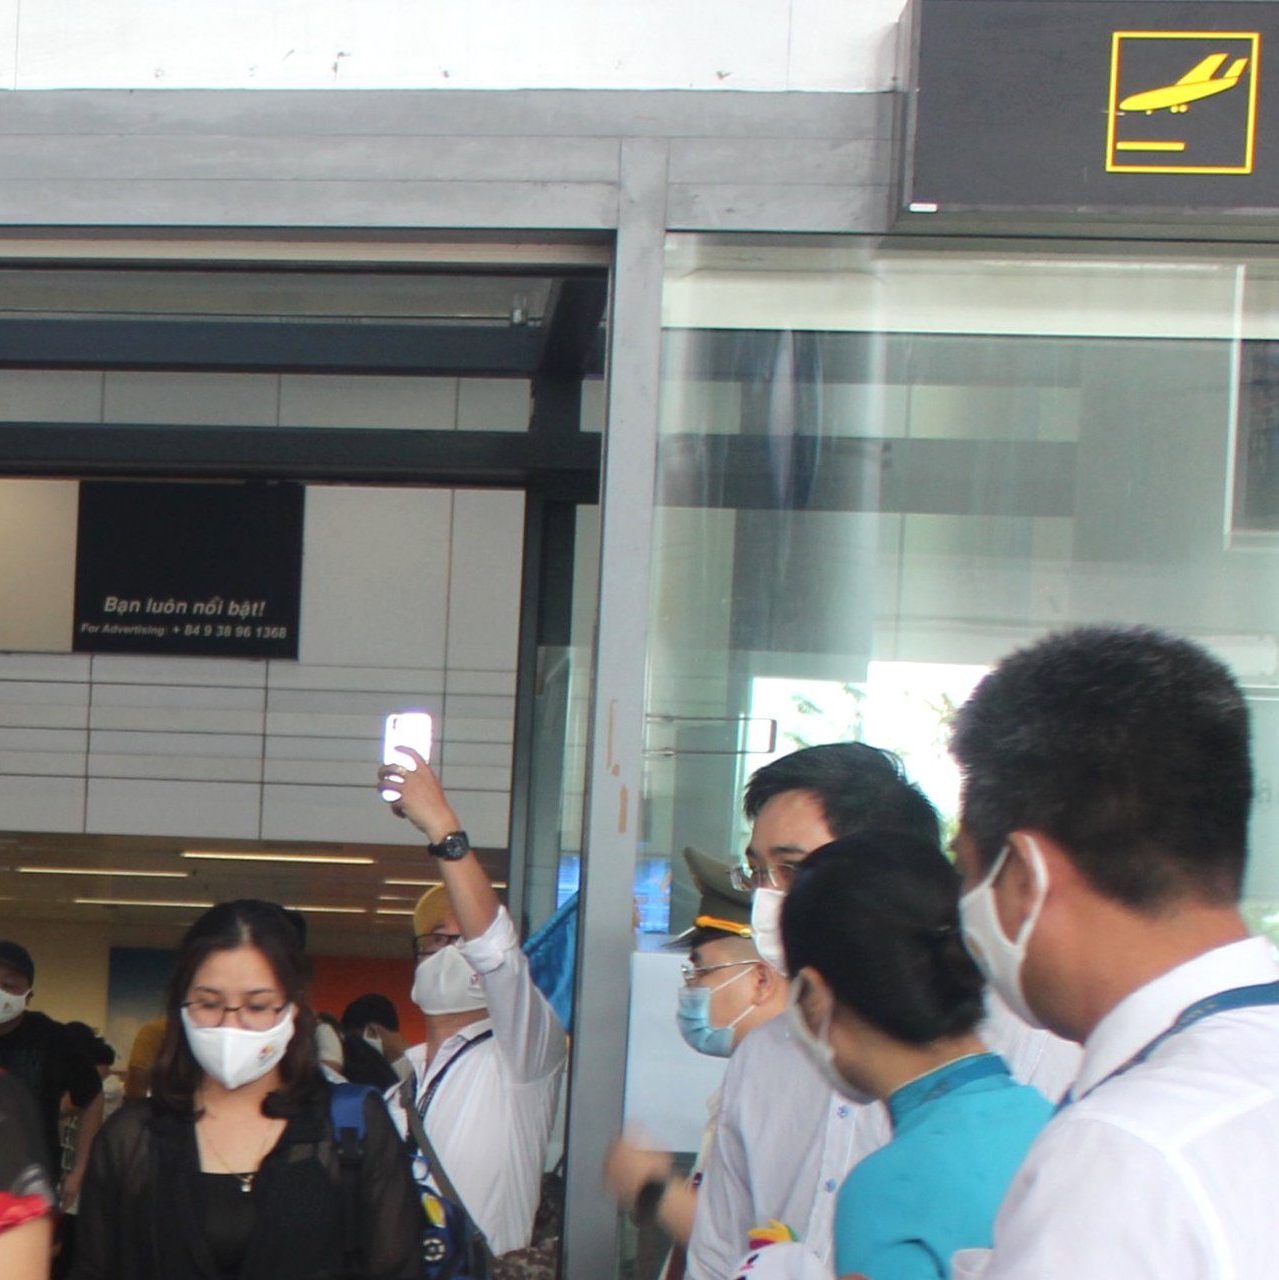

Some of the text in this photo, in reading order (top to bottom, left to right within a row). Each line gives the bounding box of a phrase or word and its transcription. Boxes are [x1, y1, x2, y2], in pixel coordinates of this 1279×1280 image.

[104, 596, 266, 619] Bạn luôn nổi bật!
[184, 625, 201, 636] 84
[204, 625, 212, 637] 9
[216, 626, 231, 637] 38
[235, 626, 251, 638] 96
[255, 626, 287, 639] 1368
